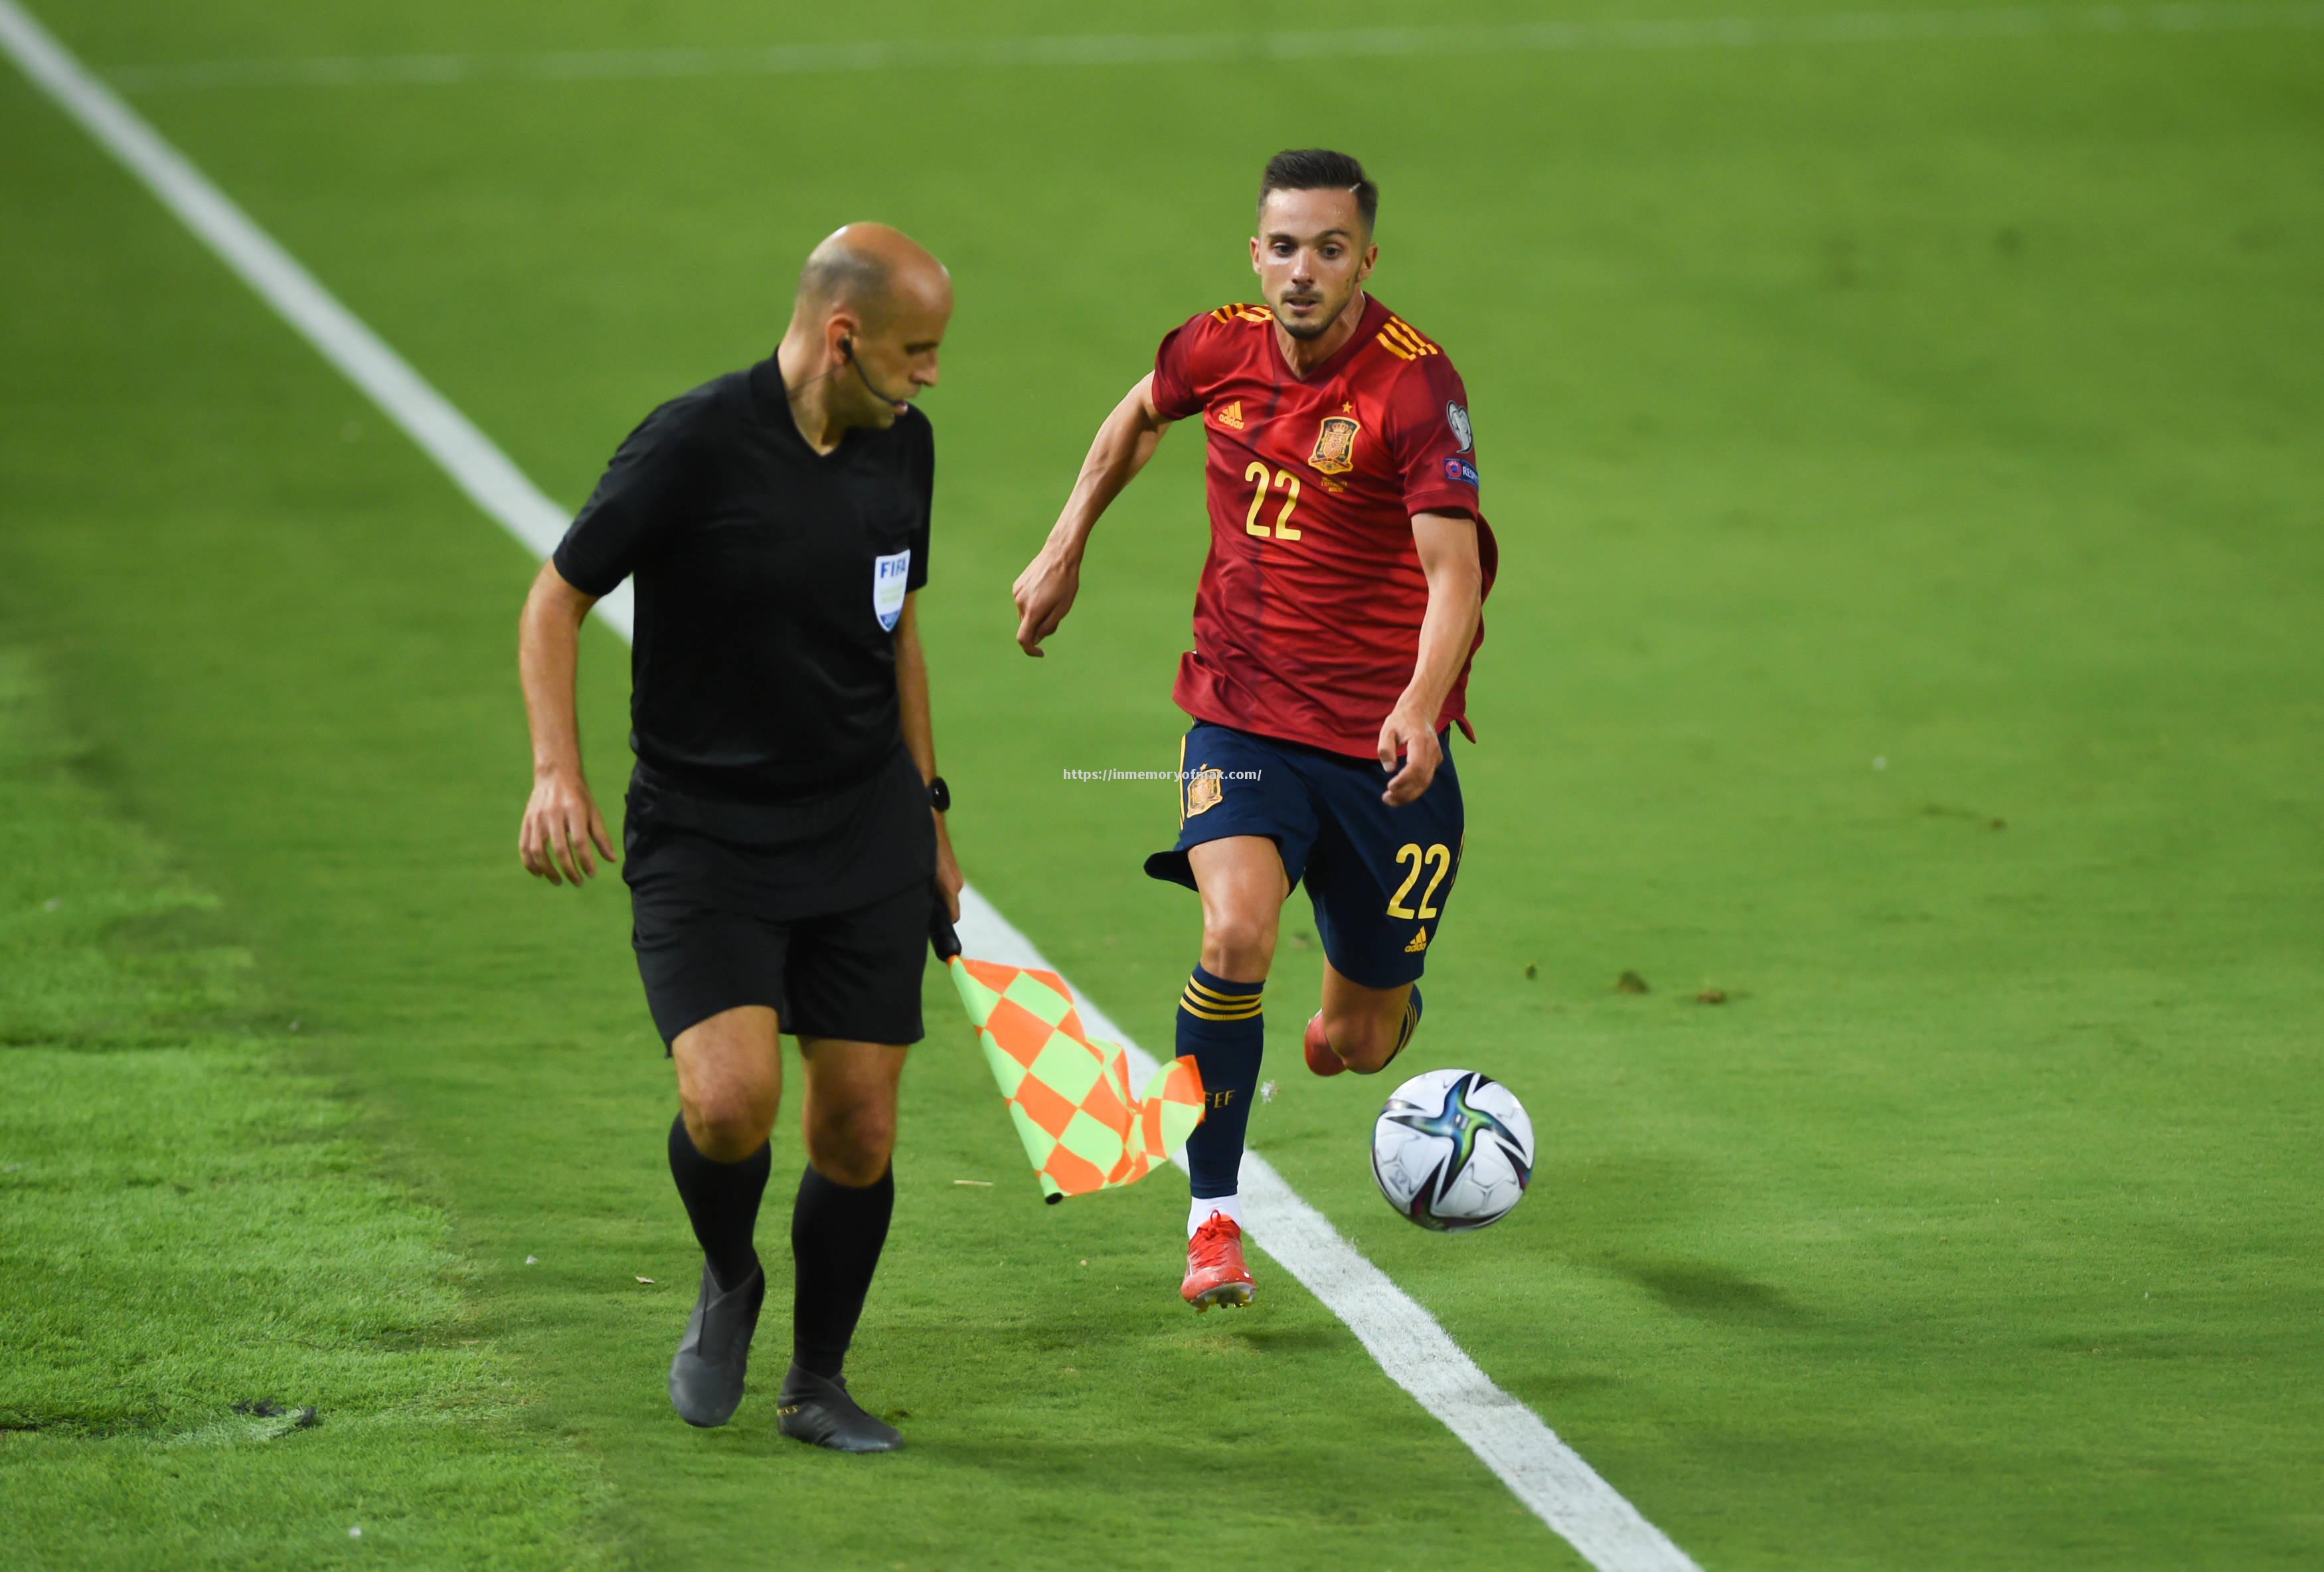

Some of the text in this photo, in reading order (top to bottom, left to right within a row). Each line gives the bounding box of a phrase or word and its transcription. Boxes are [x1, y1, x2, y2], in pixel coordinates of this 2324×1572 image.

[1218, 413, 1244, 430] adidas
[1245, 462, 1301, 541] 22
[1386, 843, 1451, 920] 22
[1404, 942, 1427, 952] adida
